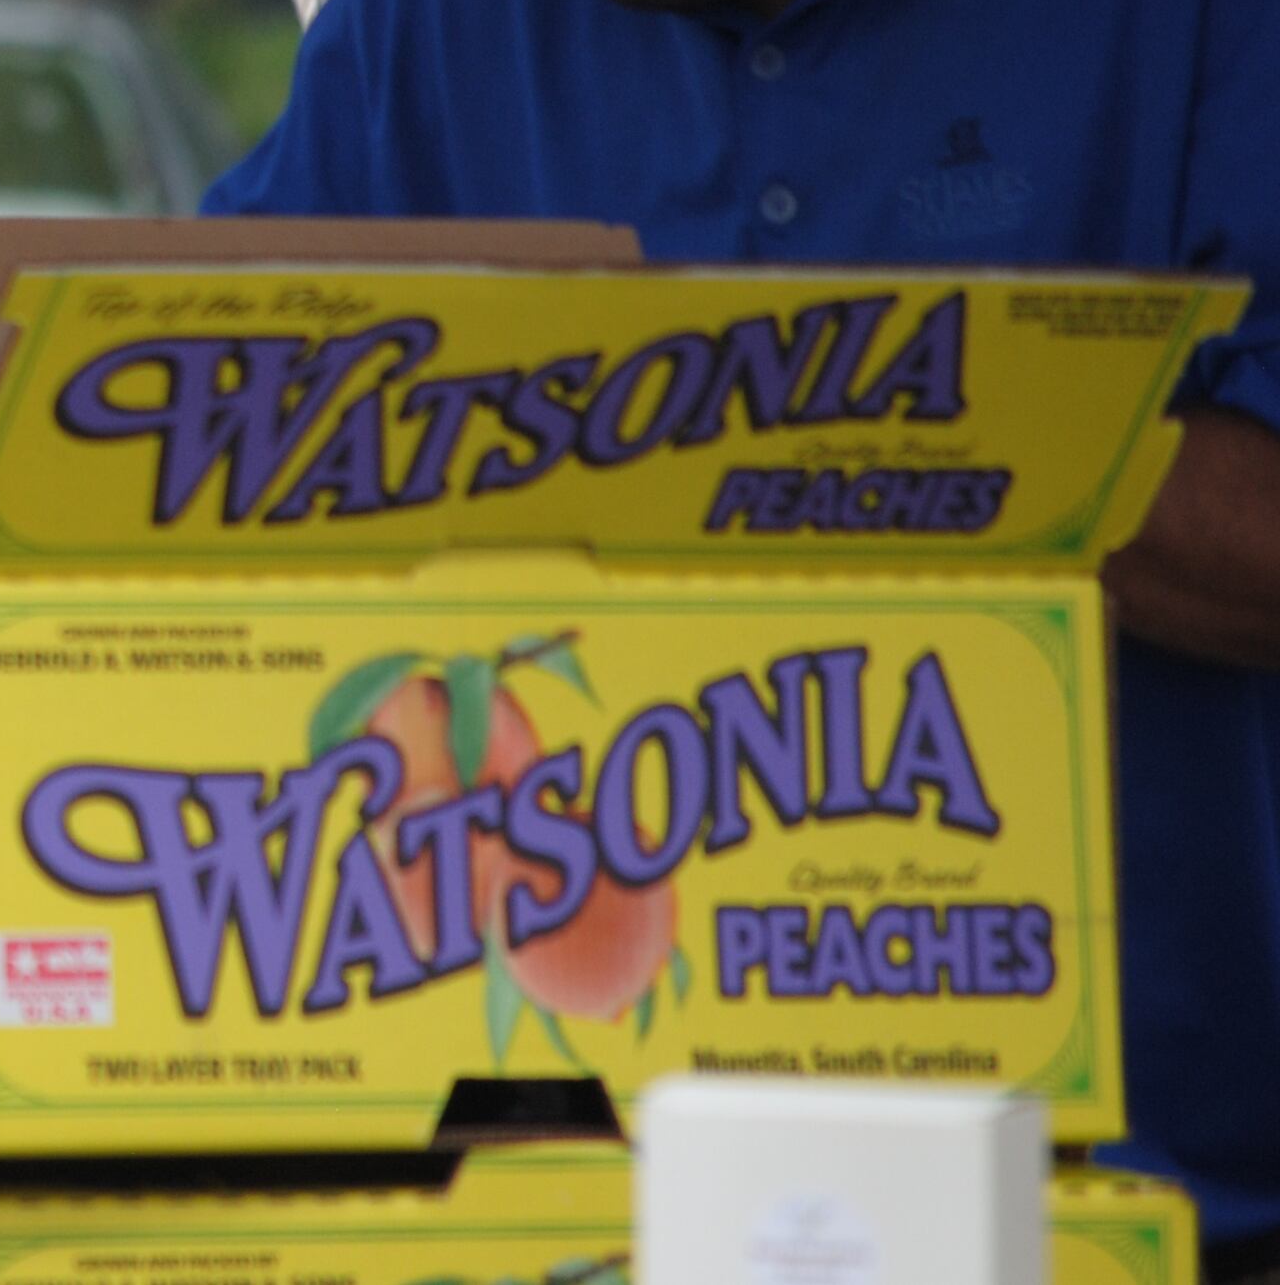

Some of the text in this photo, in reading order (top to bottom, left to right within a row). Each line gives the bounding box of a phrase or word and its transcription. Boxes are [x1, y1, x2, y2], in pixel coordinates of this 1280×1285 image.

[54, 291, 970, 528] WATSONIA
[704, 468, 1014, 534] PEACHES
[20, 644, 1002, 1022] WATSONIA
[716, 903, 1055, 999] PEACHES
